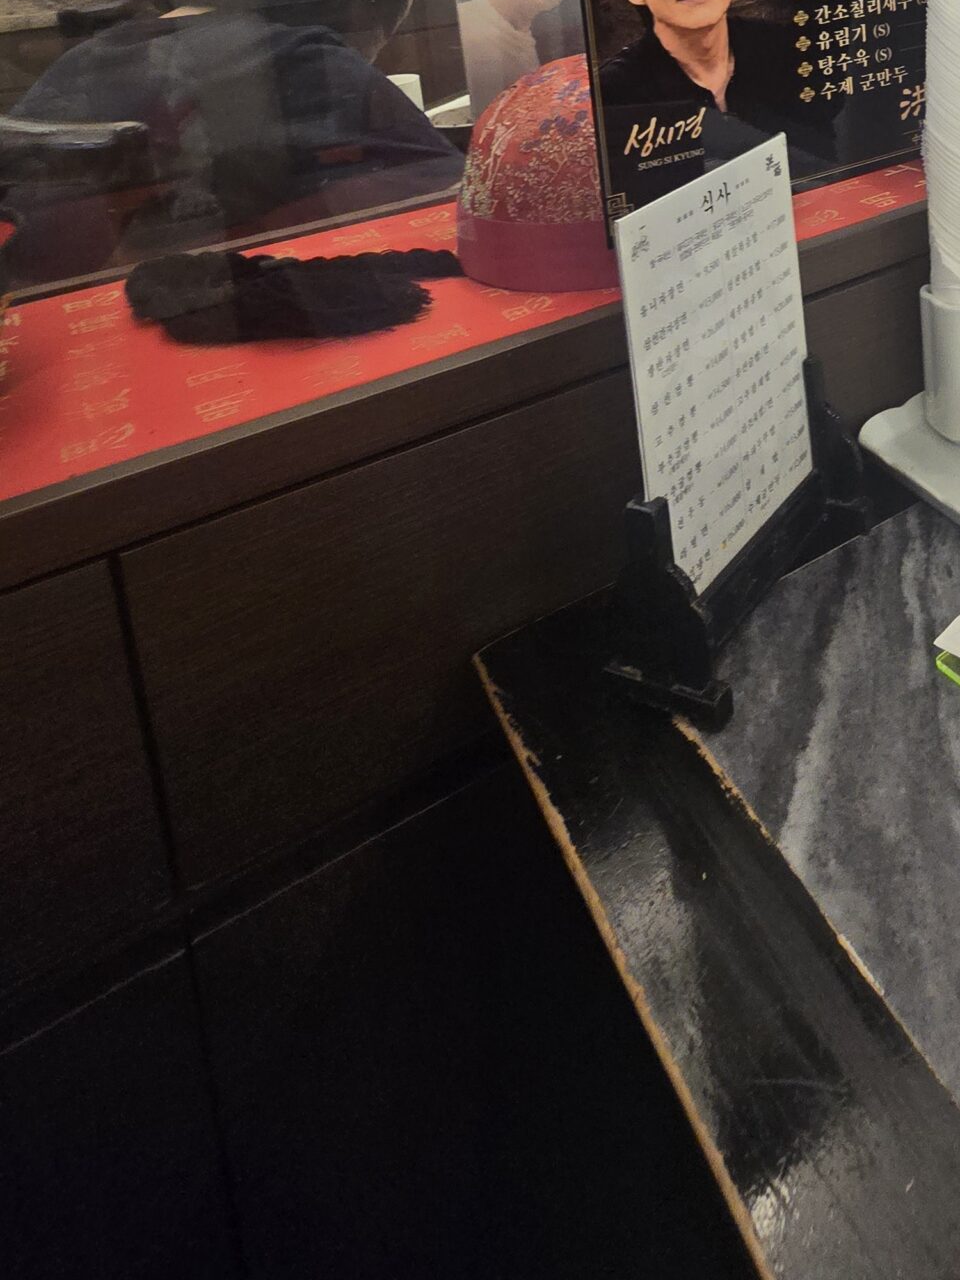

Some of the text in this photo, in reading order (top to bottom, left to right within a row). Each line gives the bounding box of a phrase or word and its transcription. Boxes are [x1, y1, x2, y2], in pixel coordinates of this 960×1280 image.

[815, 23, 891, 51] 유림기 (S)
[818, 47, 893, 76] 탕수육 (S)
[820, 65, 909, 101] 수제 군만두
[623, 106, 706, 158] 성시경
[638, 148, 706, 172] SUNG SI KYUNG
[701, 181, 732, 216] 식사
